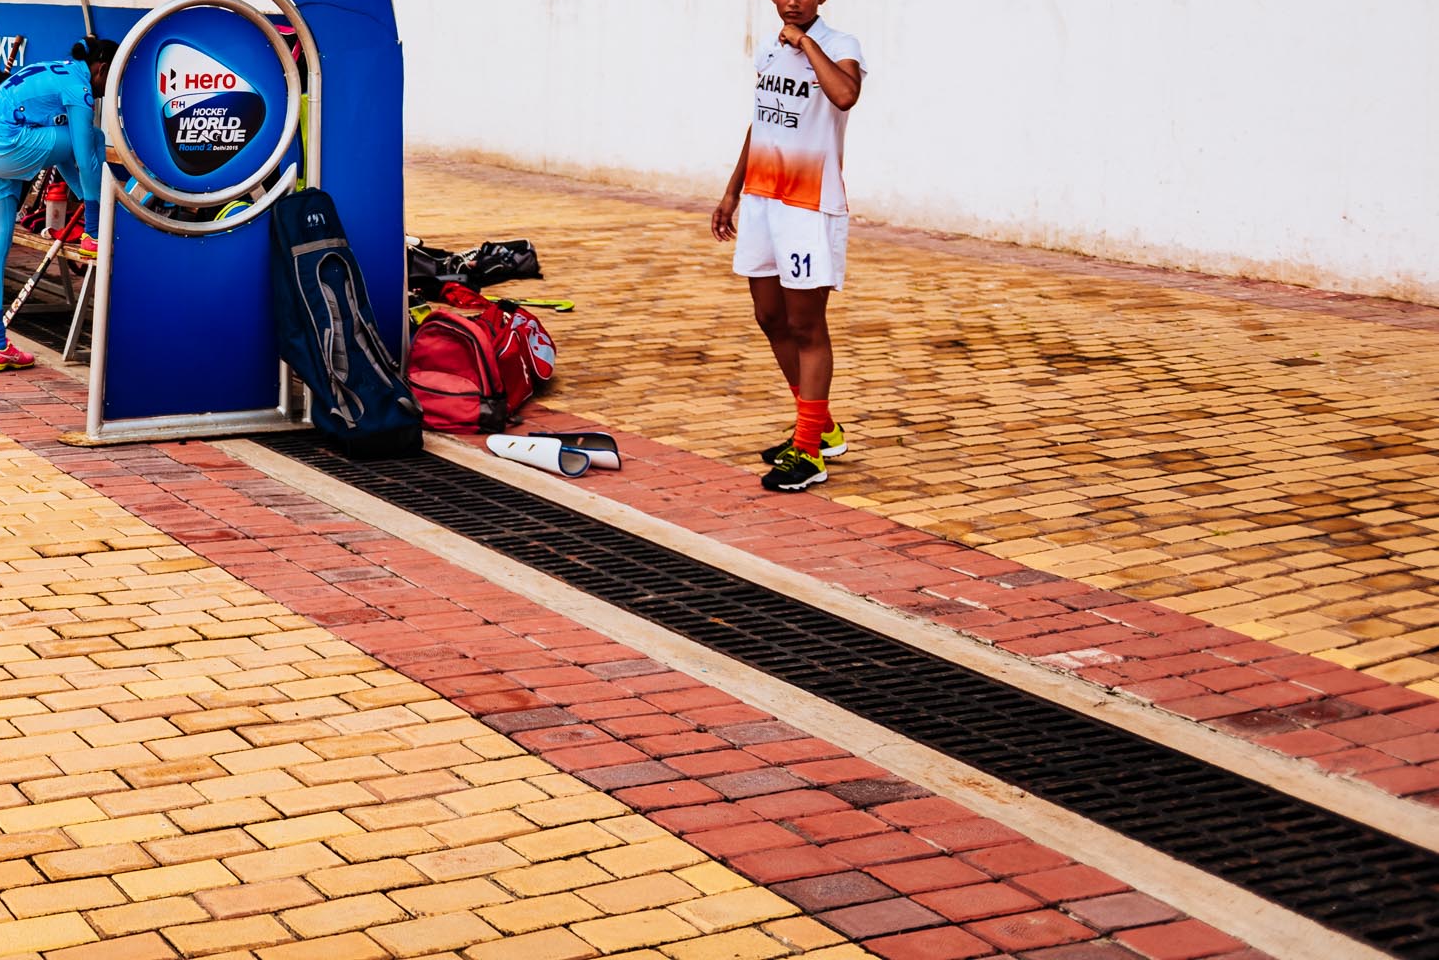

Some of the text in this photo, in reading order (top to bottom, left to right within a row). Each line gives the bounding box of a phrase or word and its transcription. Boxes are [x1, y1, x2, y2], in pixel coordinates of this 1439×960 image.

[185, 73, 236, 89] Hero
[192, 108, 228, 116] HOCKEY
[179, 117, 241, 130] WORLD
[175, 129, 247, 143] LEAGUE
[178, 143, 205, 151] Round
[206, 143, 213, 151] 2
[790, 253, 812, 279] 31
